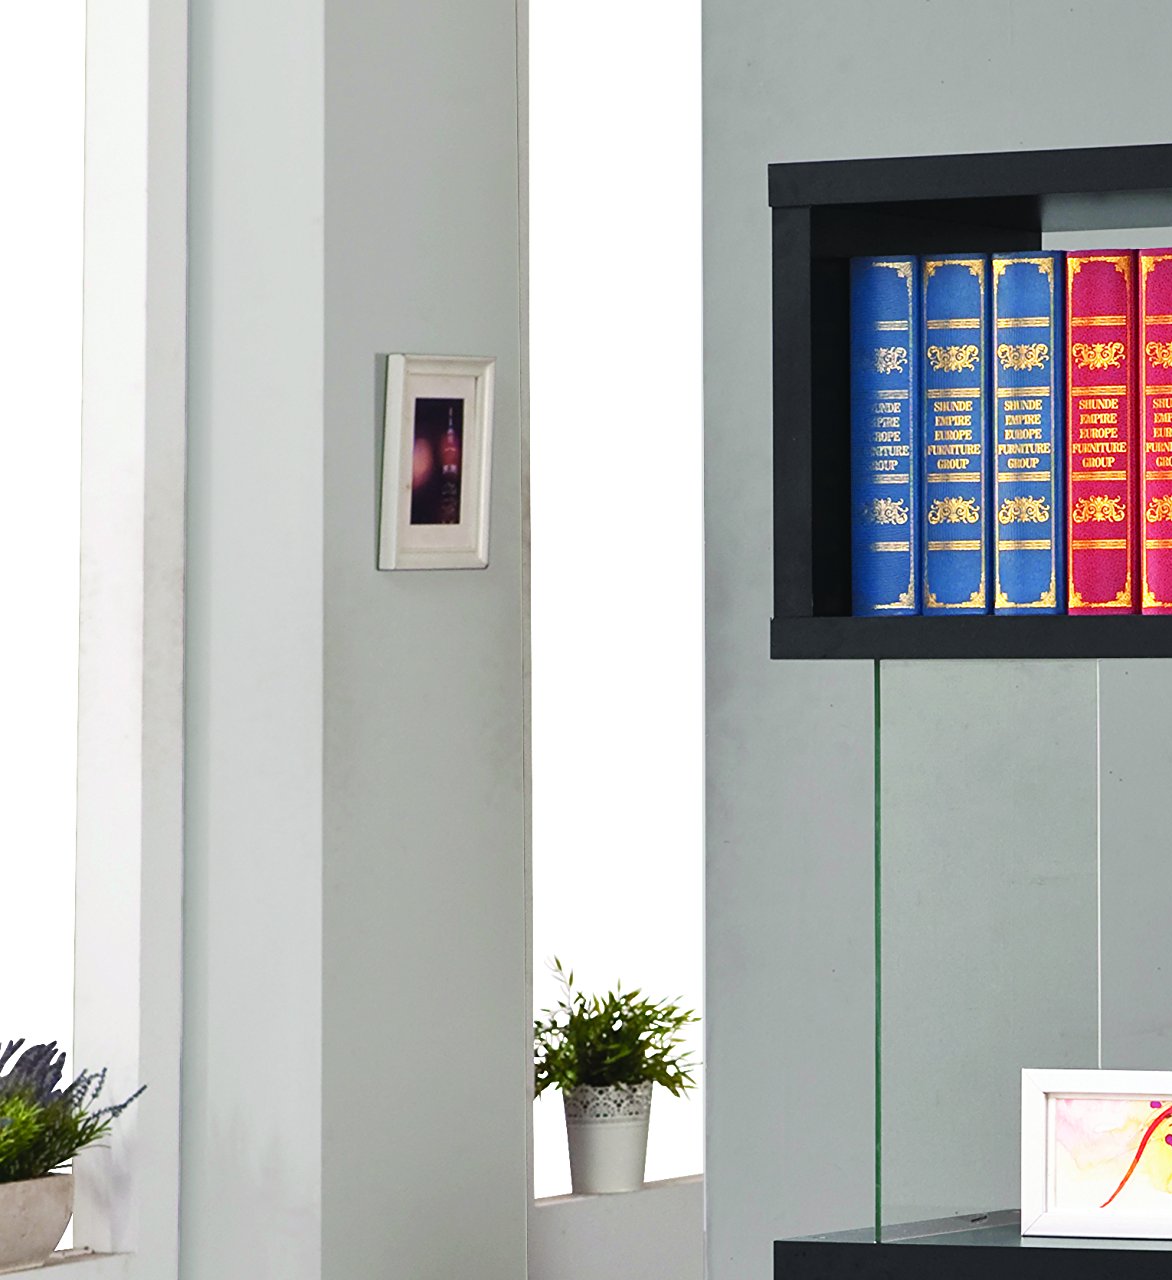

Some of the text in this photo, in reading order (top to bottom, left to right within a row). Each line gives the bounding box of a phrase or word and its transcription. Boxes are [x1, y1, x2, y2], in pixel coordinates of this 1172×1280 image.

[933, 400, 973, 413] SHUNDE
[1003, 399, 1043, 411] SHUNDE
[1078, 398, 1119, 410] SHUNDE
[935, 415, 972, 427] EMPIRE
[1005, 413, 1042, 426] EMPIRE
[1079, 413, 1118, 425] EMPIRE
[934, 429, 973, 441] EUROPE
[1004, 428, 1042, 440] EUROPE
[1079, 427, 1118, 439] EUROPE
[927, 444, 981, 456] FURNITURE
[998, 442, 1051, 455] FURNITURE
[1072, 442, 1127, 454] FURNITURE
[937, 458, 970, 470] GROUP
[1007, 457, 1040, 469] GROUP
[1081, 456, 1115, 468] GROUP
